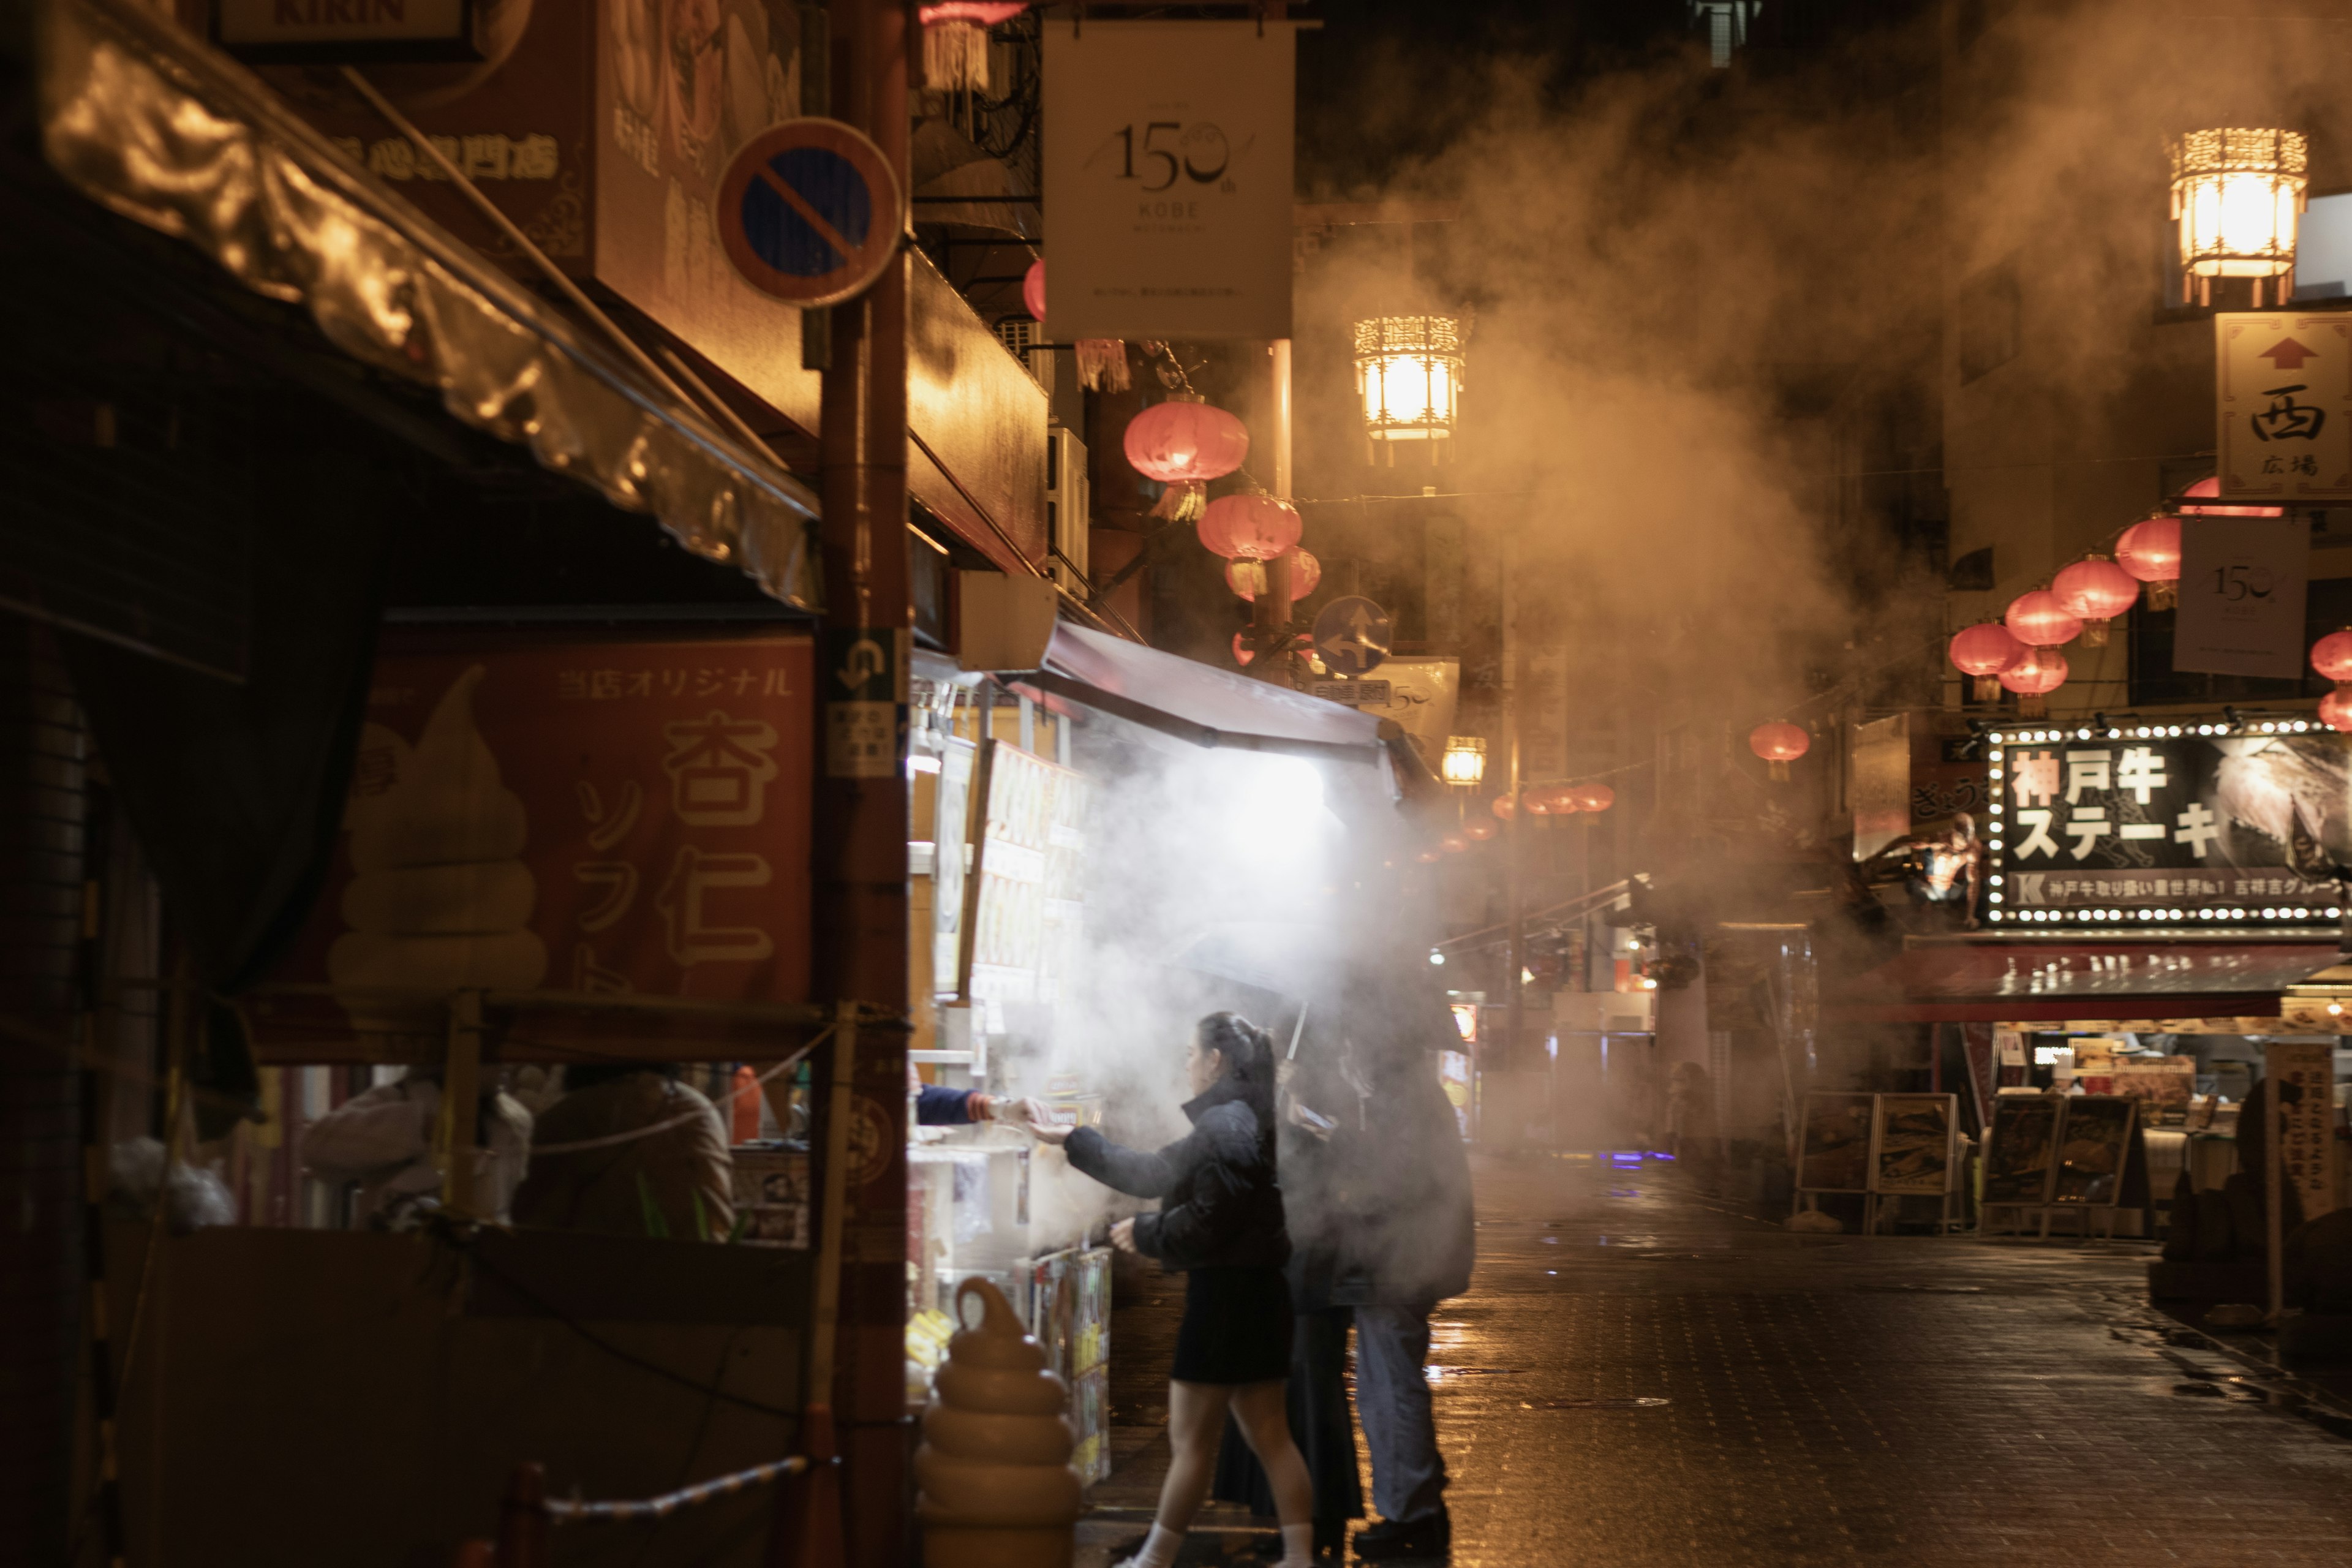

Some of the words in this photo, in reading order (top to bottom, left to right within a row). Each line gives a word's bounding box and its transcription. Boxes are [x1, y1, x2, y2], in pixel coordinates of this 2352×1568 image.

[1138, 202, 1197, 217] KOBE
[2250, 383, 2326, 442] 西
[2261, 454, 2319, 477] 広場
[557, 666, 794, 700] 当店オリジナル
[2011, 746, 2168, 807] 神戸牛
[2013, 802, 2220, 861] ステーキ
